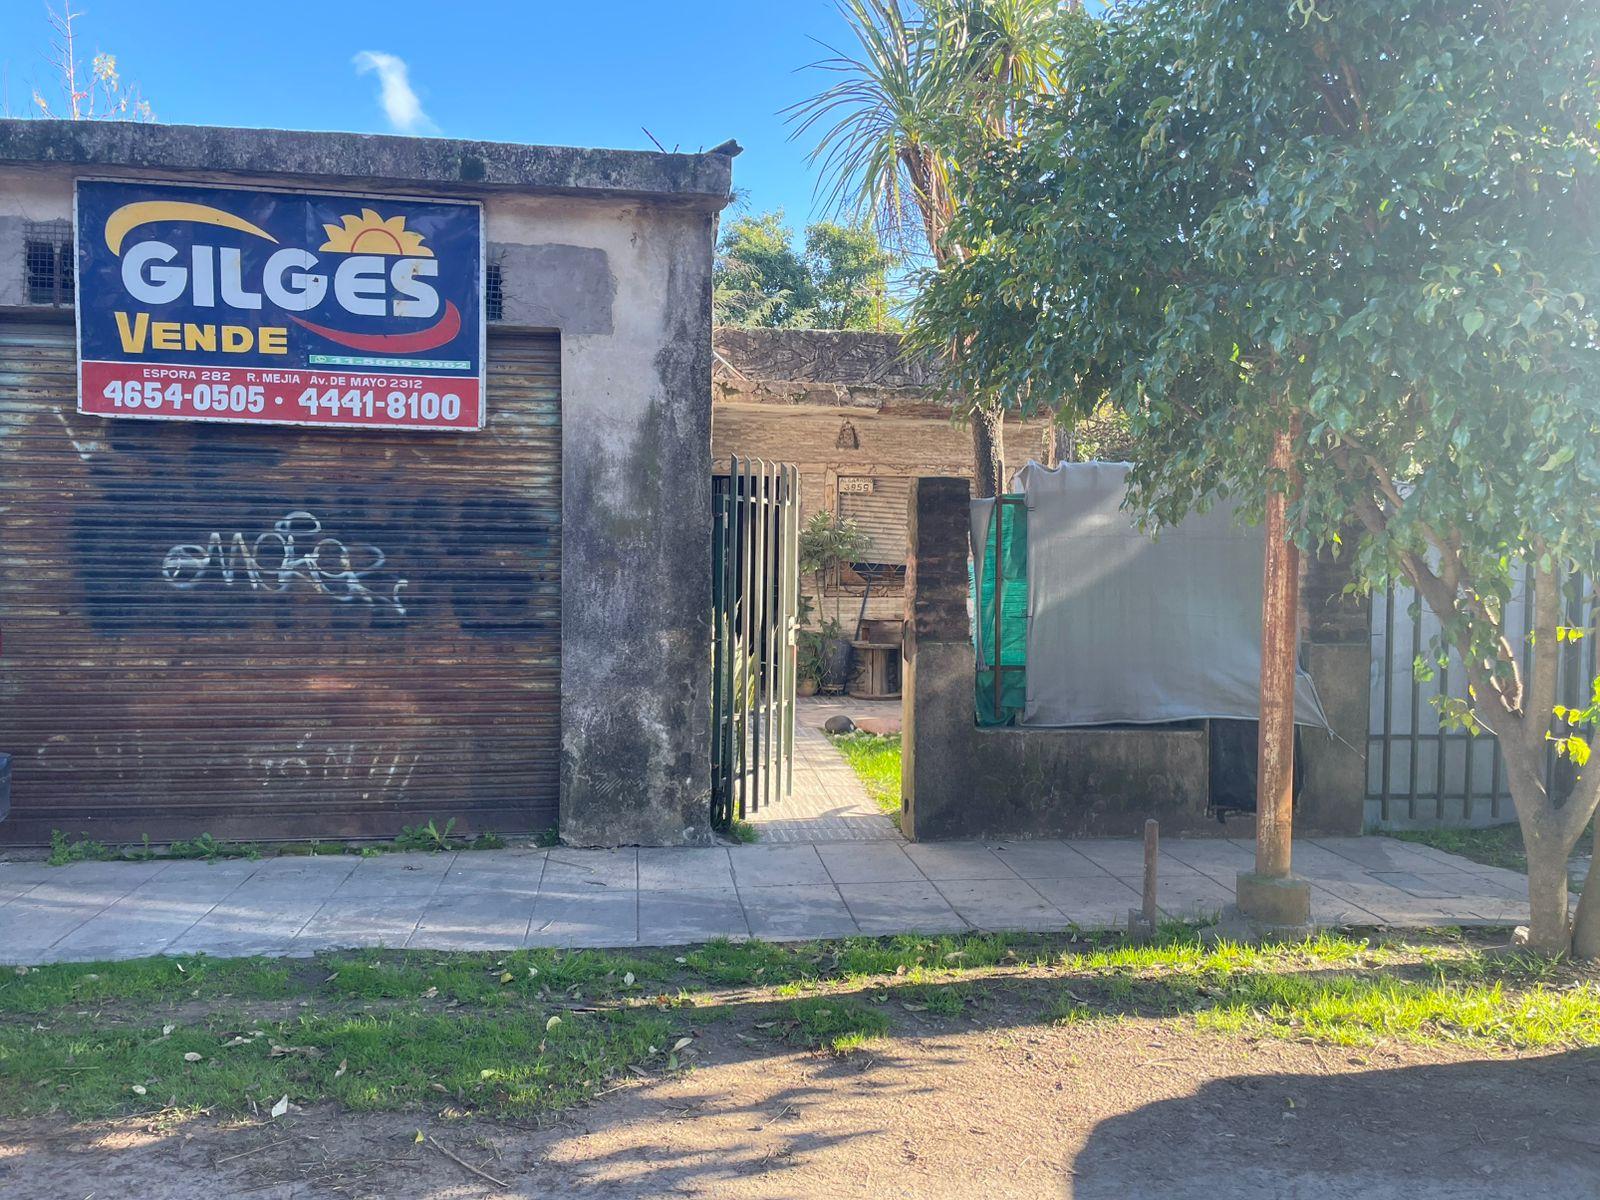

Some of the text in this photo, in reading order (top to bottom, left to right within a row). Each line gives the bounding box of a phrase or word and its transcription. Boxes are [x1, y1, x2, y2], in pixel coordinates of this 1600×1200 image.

[121, 240, 440, 319] GILGES
[114, 311, 288, 355] VENDE
[143, 368, 197, 380] ESPORA
[201, 371, 231, 382] 282
[246, 373, 259, 383] R.
[262, 373, 300, 384] MEJIA
[330, 376, 346, 386] DE
[350, 377, 387, 388] MAYO
[389, 379, 423, 389] 2312
[103, 380, 461, 421] 4654-0505 4441-8100
